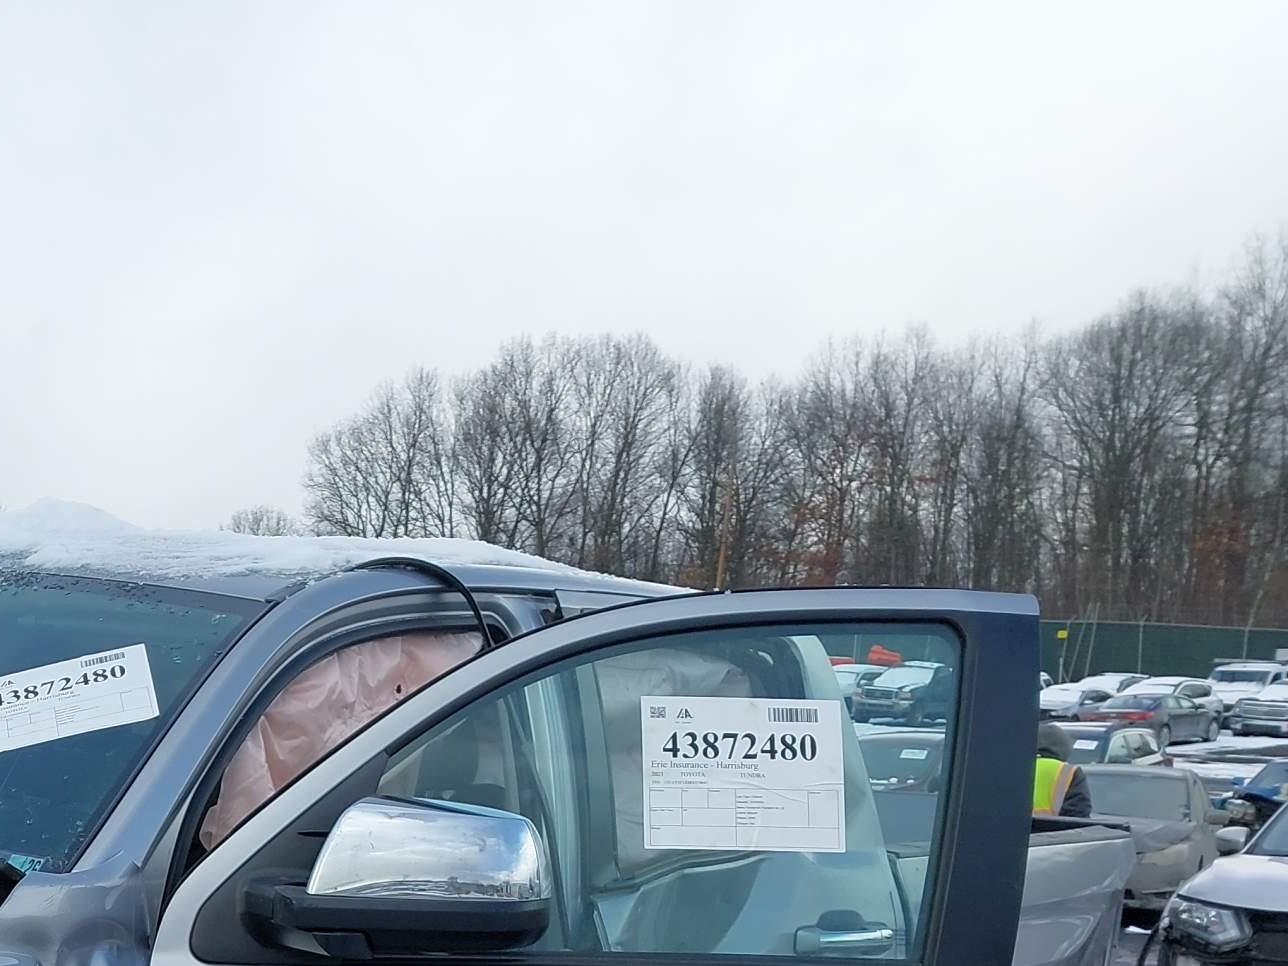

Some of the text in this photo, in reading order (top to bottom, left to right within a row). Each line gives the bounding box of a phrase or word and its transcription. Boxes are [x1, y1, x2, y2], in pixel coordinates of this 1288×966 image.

[662, 731, 817, 761] 43872480
[651, 760, 668, 769] Erie
[670, 760, 709, 769] Insurance
[716, 761, 759, 771] Harrisburg
